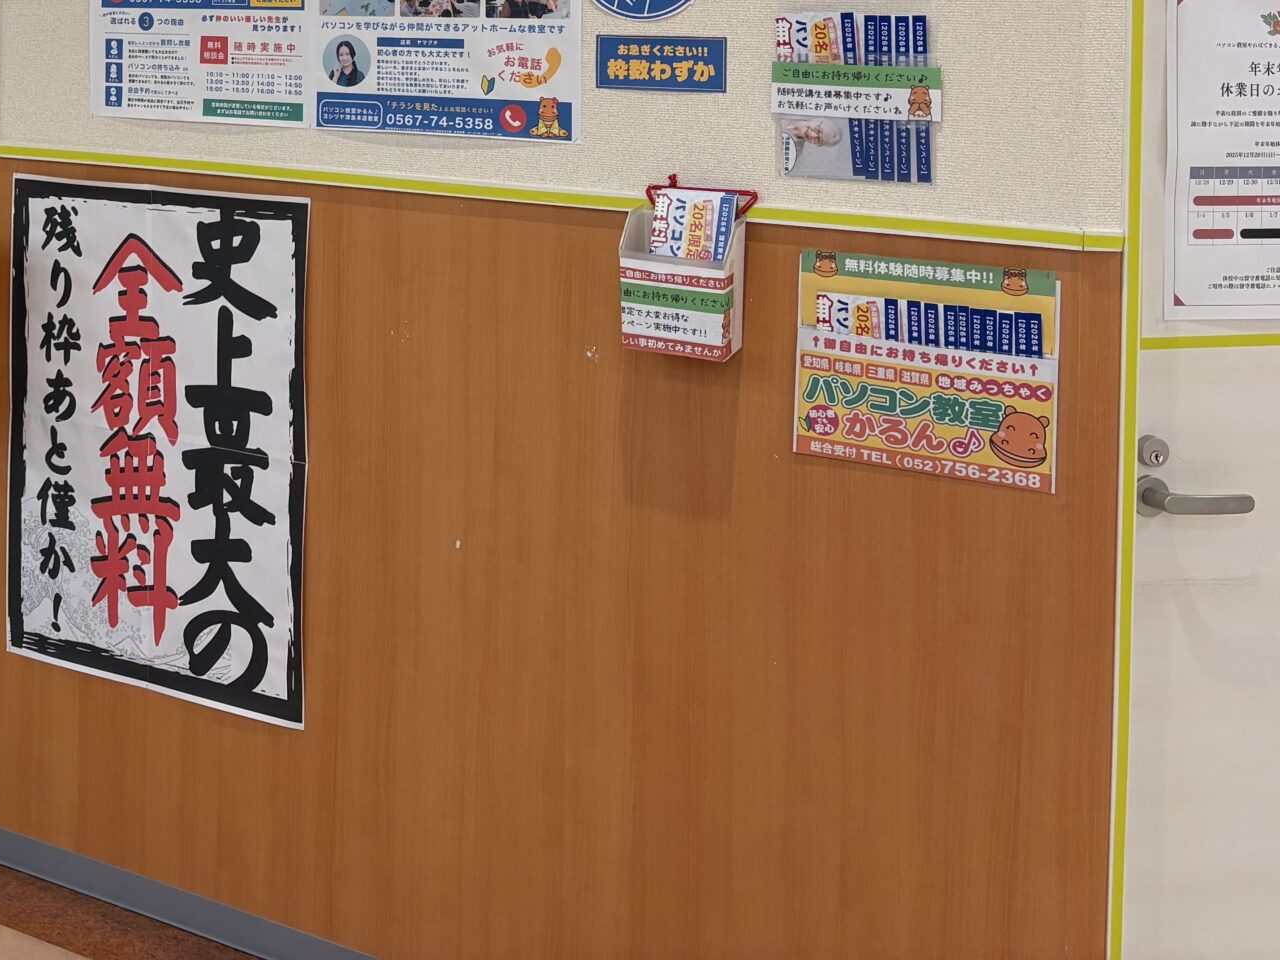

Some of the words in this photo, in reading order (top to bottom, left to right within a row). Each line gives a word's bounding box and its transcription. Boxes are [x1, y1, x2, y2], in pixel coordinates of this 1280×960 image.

[110, 17, 137, 25] 選ばれる
[156, 18, 185, 26] つの理由
[251, 24, 303, 33] 見つかります！
[321, 21, 566, 35] パソコンを学びながら仲間ができるアットホームな教室です
[207, 41, 222, 49] 無料
[233, 41, 297, 54] 随時実施中
[486, 42, 525, 58] お気軽に
[616, 44, 709, 58] お急ぎください!!
[376, 48, 471, 59] 初心者の方でも大丈夫です！
[127, 62, 181, 72] パソコンの持ち込み
[503, 56, 543, 71] お電話
[606, 58, 716, 82] 枠数わずか
[231, 71, 250, 79] 11:00
[496, 70, 548, 86] ください
[284, 81, 303, 89] 14:50
[284, 88, 303, 96] 16:50
[777, 100, 903, 116] お気軽にお声がけくださいね
[385, 113, 494, 130] 0567-74-5358
[669, 197, 687, 257] パソコン
[685, 203, 705, 261] 20名限定
[844, 257, 994, 285] 無料体験随時募集中!!
[622, 335, 722, 358] しい事初めてみませんか
[803, 355, 831, 369] 愛知県
[823, 337, 1027, 375] 御自由にお持ち帰りください
[835, 360, 863, 375] 岐阜県
[867, 365, 896, 381] 三重県
[901, 370, 931, 386] 滋賀県
[937, 375, 1050, 400] 地域みっちゃく
[803, 372, 1006, 433] パソコン教室
[36, 205, 83, 633] 残り枠あと僅か!
[809, 409, 836, 419] 初心者
[814, 423, 835, 434] 安心
[842, 409, 948, 455] かるん
[90, 232, 183, 648] 全額無料
[178, 219, 278, 693] 史上最大の
[809, 441, 857, 458] 総合受付
[860, 447, 892, 465] TEL
[895, 454, 1041, 489] (052)756-2368
